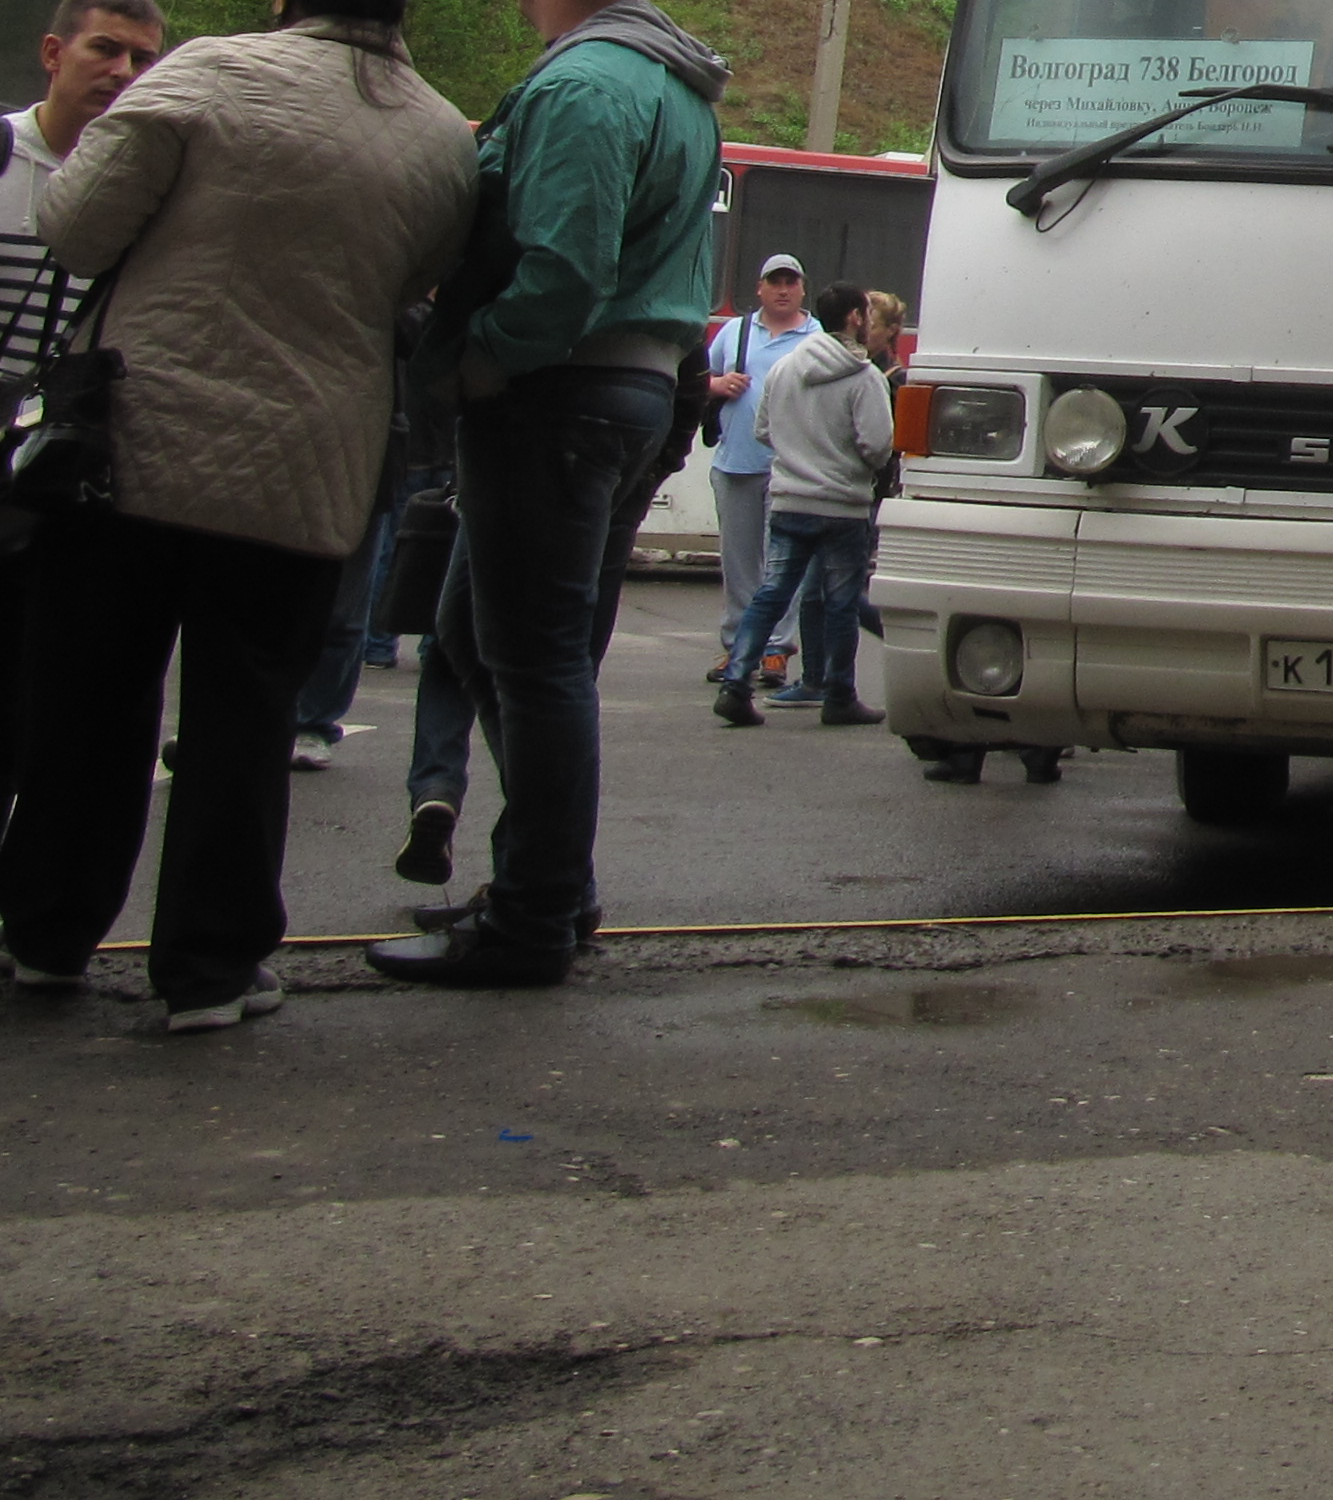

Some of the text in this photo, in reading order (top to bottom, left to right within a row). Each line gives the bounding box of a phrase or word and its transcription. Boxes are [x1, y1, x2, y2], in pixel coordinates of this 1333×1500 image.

[1009, 54, 1298, 87] Волгоград 738 Белгород
[1024, 98, 1061, 112] через
